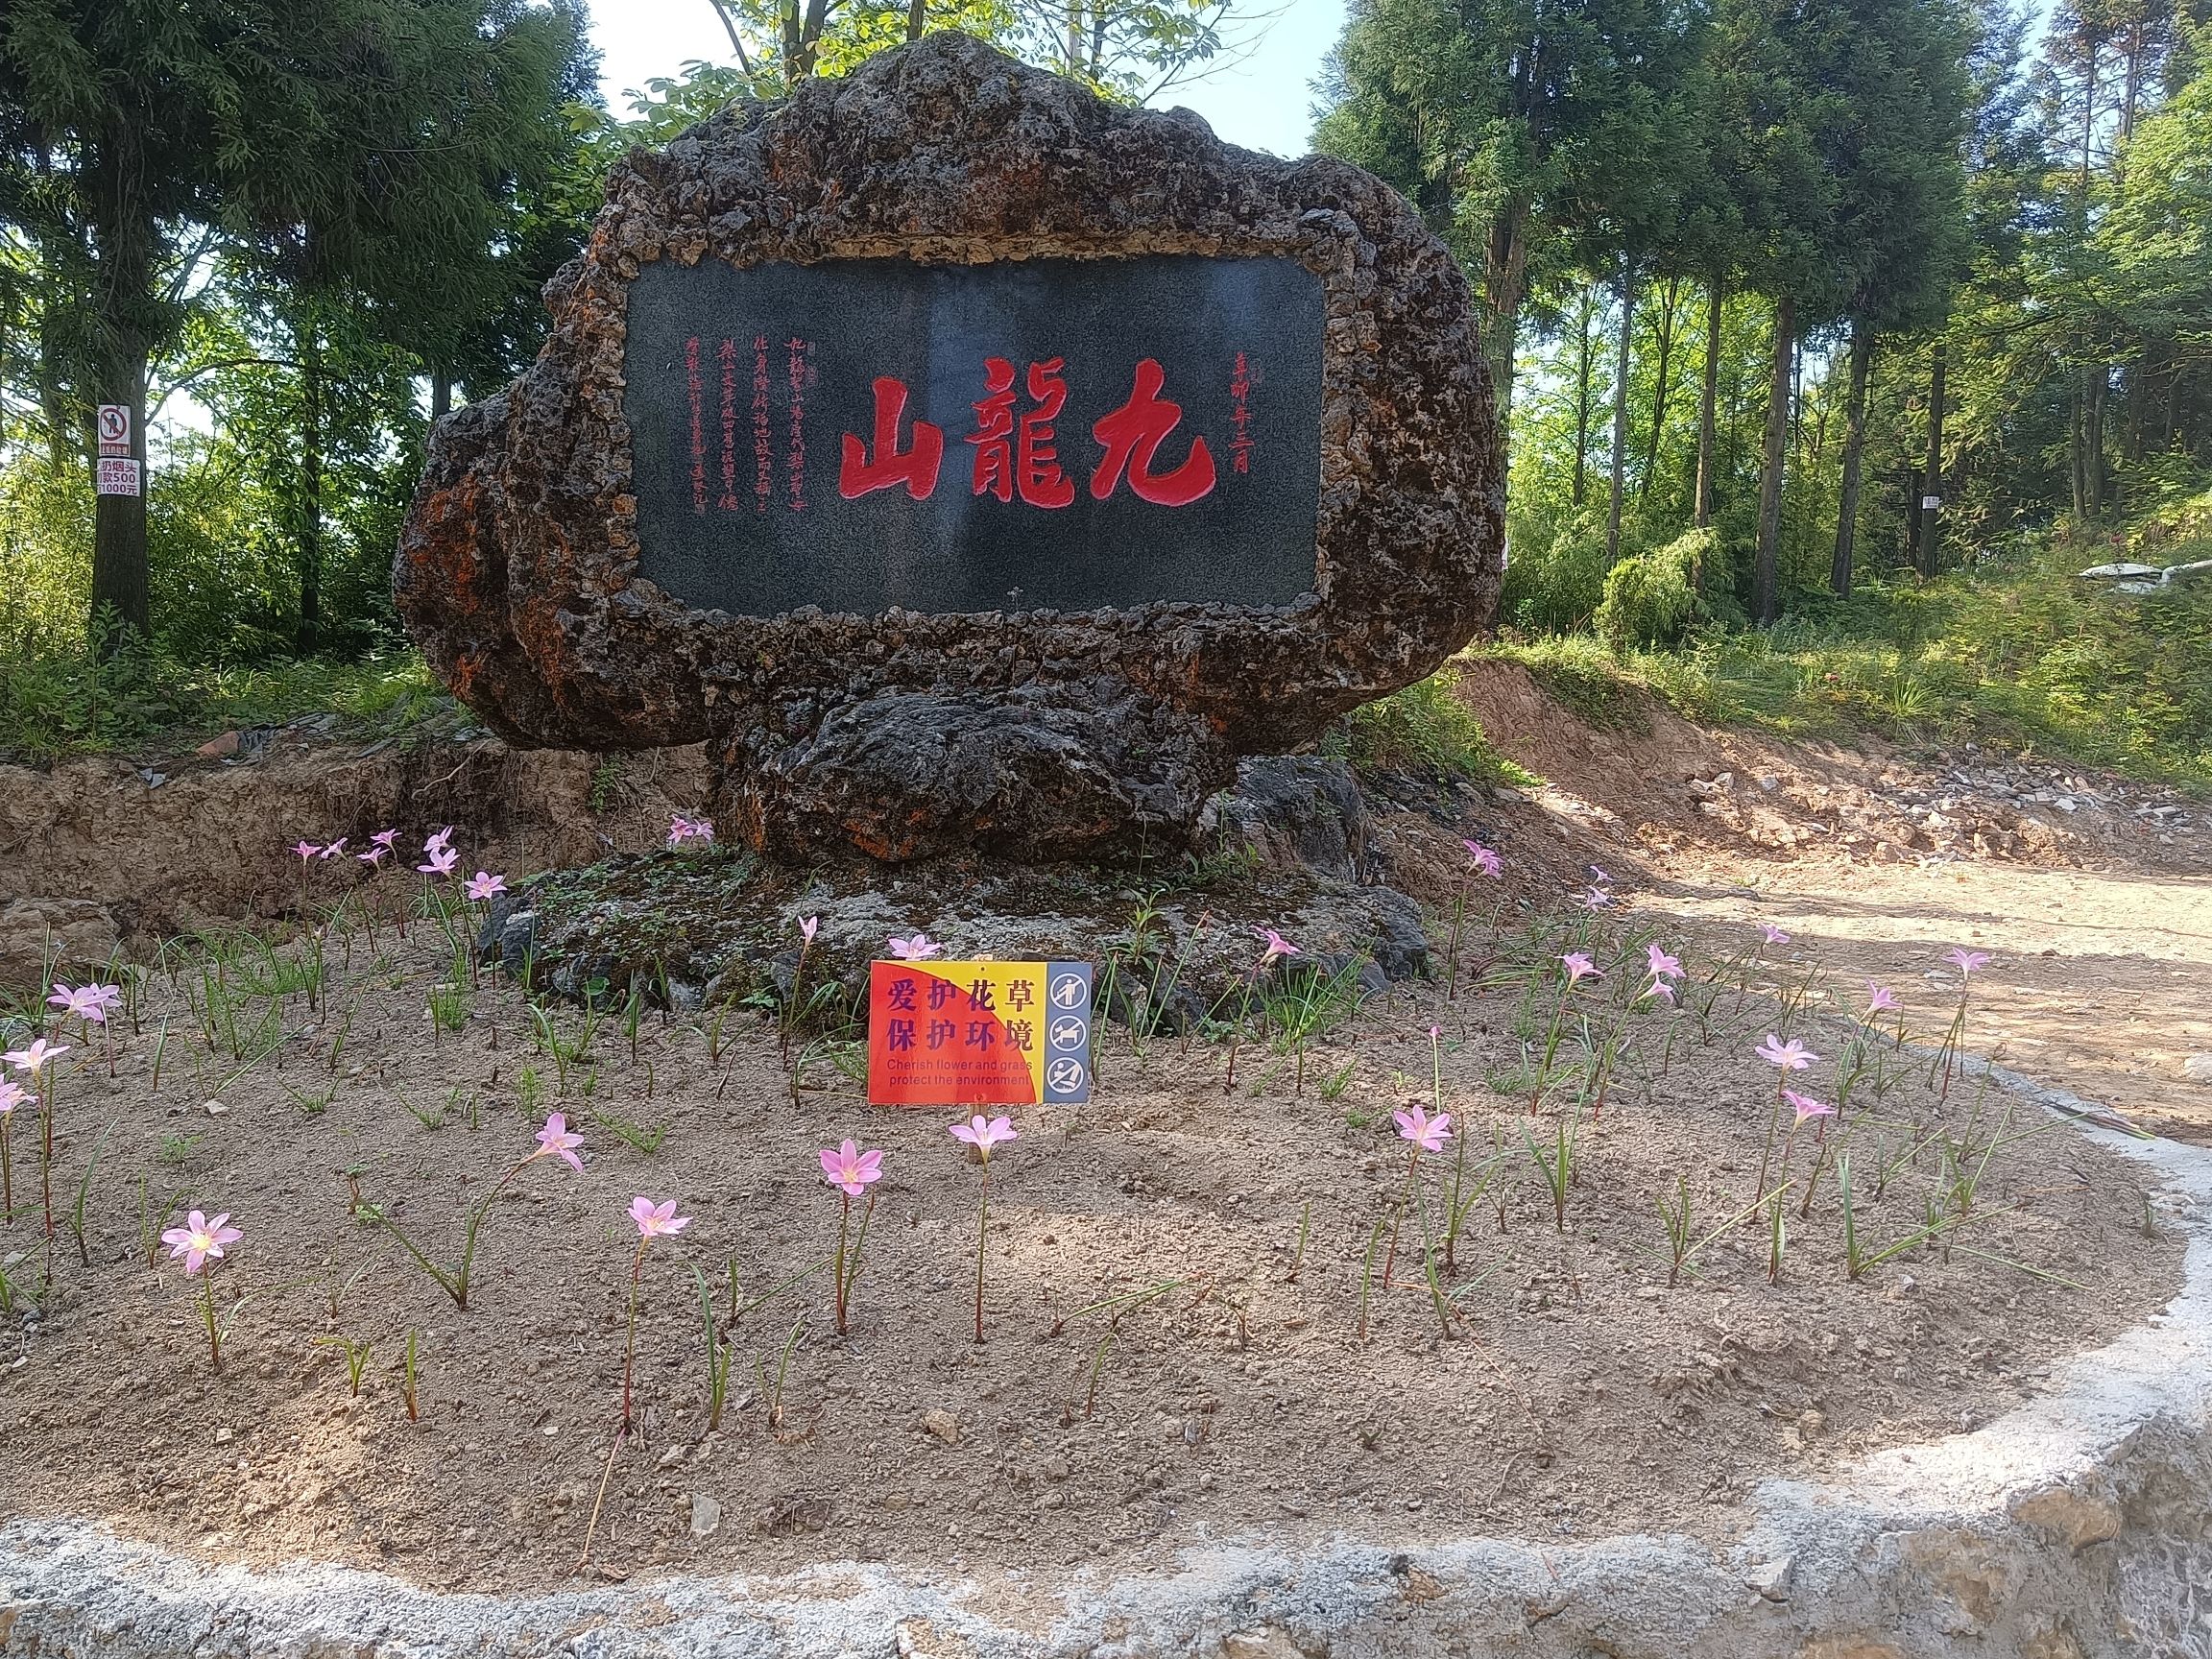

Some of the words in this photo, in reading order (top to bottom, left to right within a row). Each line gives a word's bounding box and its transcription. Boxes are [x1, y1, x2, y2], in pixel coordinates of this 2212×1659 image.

[887, 978, 1034, 1012] 爱护花草
[886, 1019, 1034, 1052] 保护环境
[887, 1059, 933, 1070] Cherish
[936, 1059, 973, 1070] flower
[975, 1059, 998, 1070] and
[1000, 1061, 1033, 1073] grass
[889, 1074, 931, 1086] protect
[934, 1074, 954, 1085] the
[956, 1074, 1029, 1086] environment
